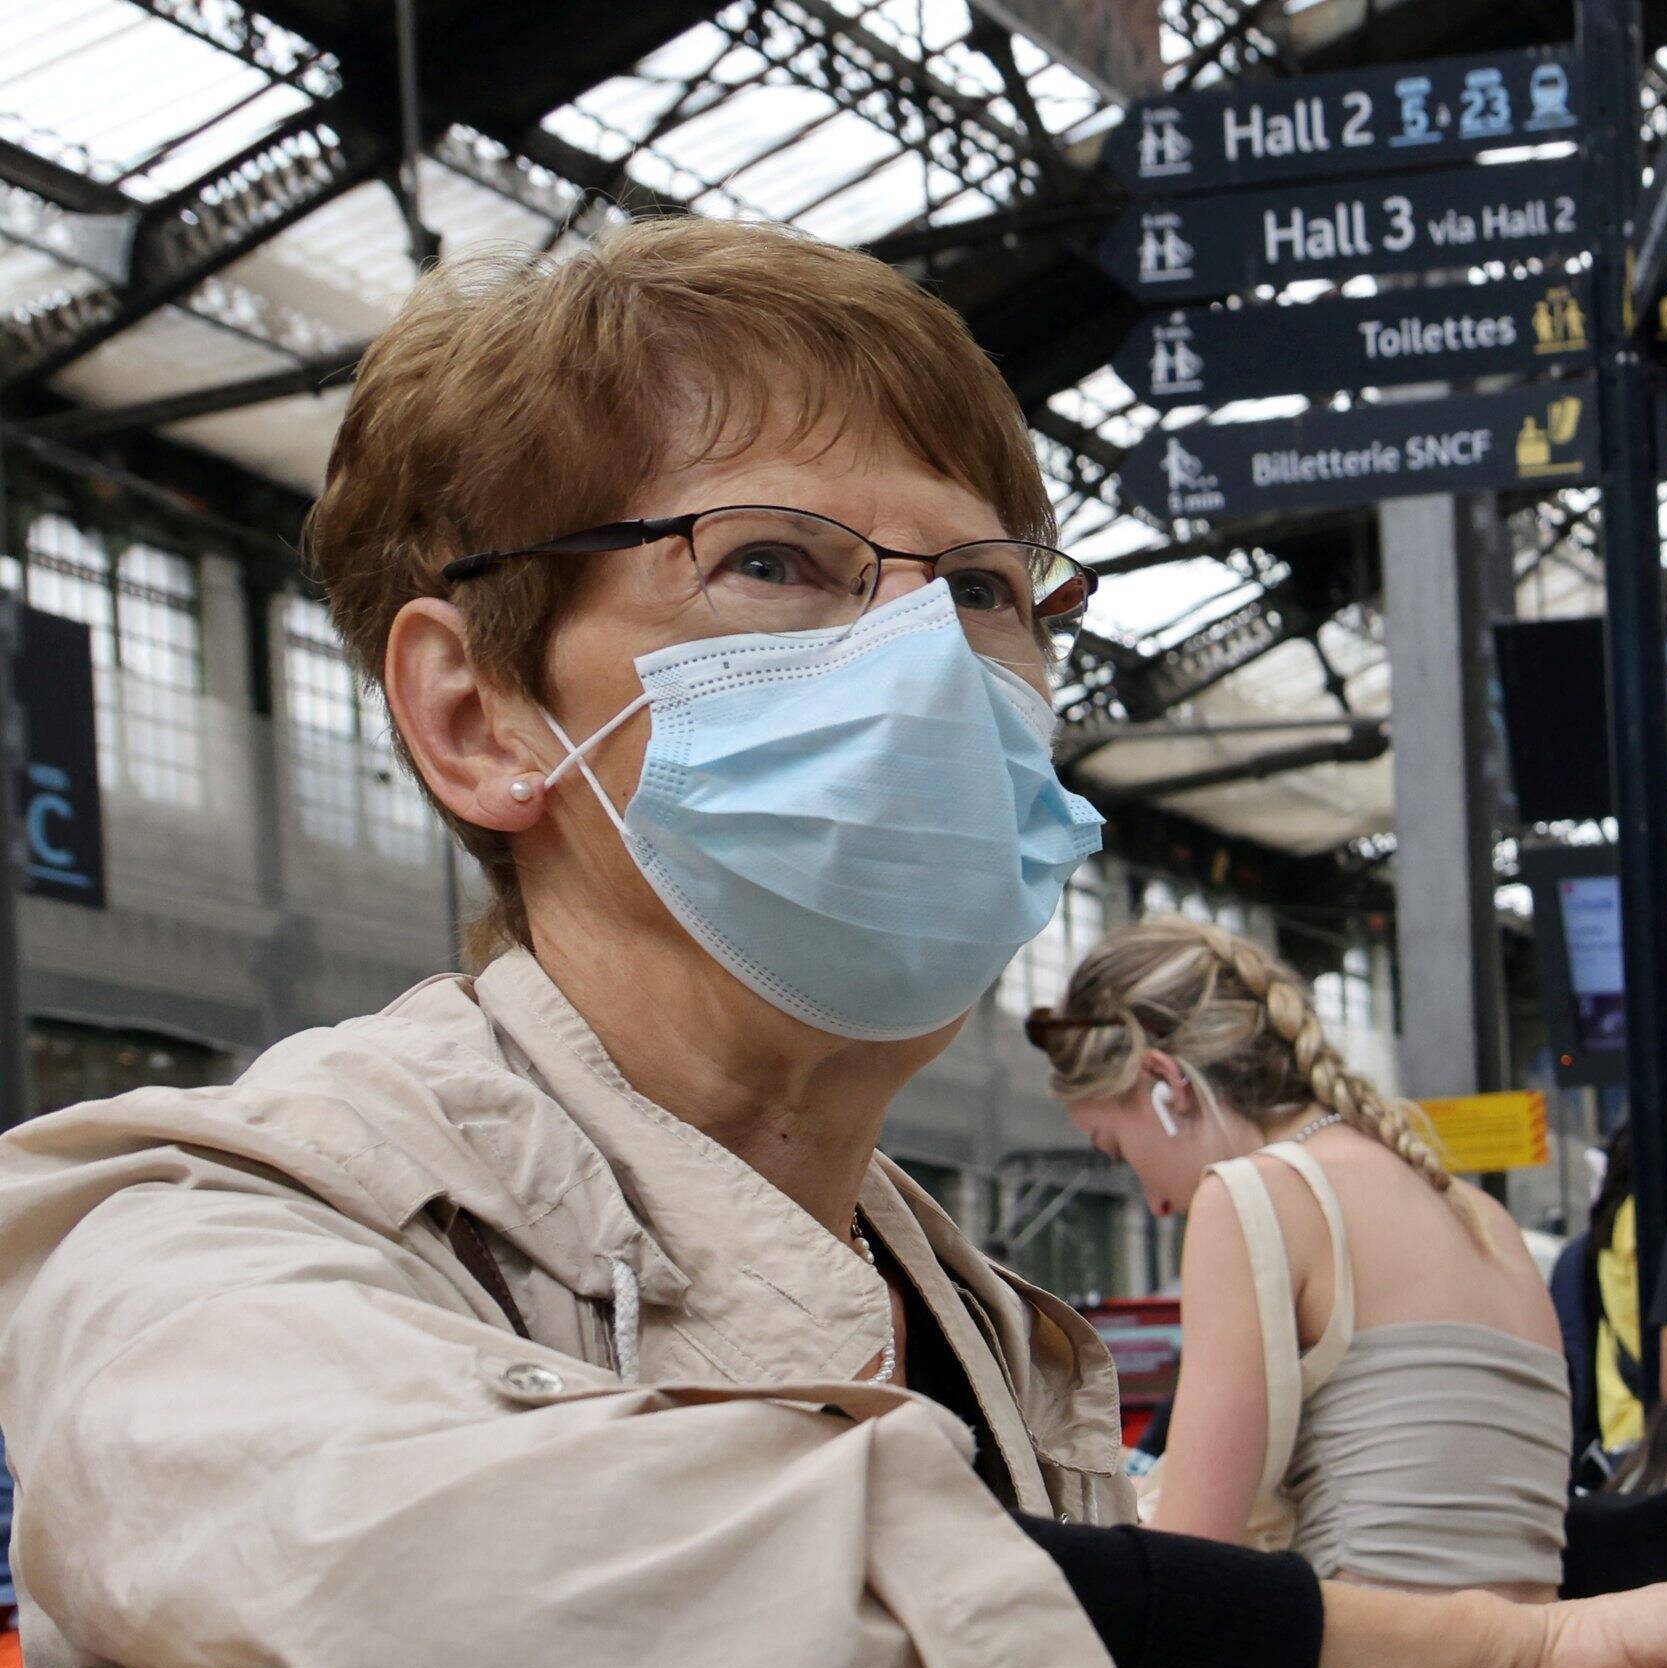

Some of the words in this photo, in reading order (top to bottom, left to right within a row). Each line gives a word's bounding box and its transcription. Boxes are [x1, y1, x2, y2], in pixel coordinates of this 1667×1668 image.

[1223, 96, 1331, 161] Hall
[1342, 90, 1375, 147] 2
[1460, 86, 1512, 133] 23
[1263, 199, 1373, 264] Hall
[1383, 195, 1416, 251] 3
[1427, 208, 1477, 246] via
[1482, 200, 1549, 241] Hall
[1554, 196, 1576, 233] 2
[1358, 315, 1517, 359] Toilettes
[1252, 440, 1400, 487] Billetterie
[1405, 428, 1492, 471] SNCF
